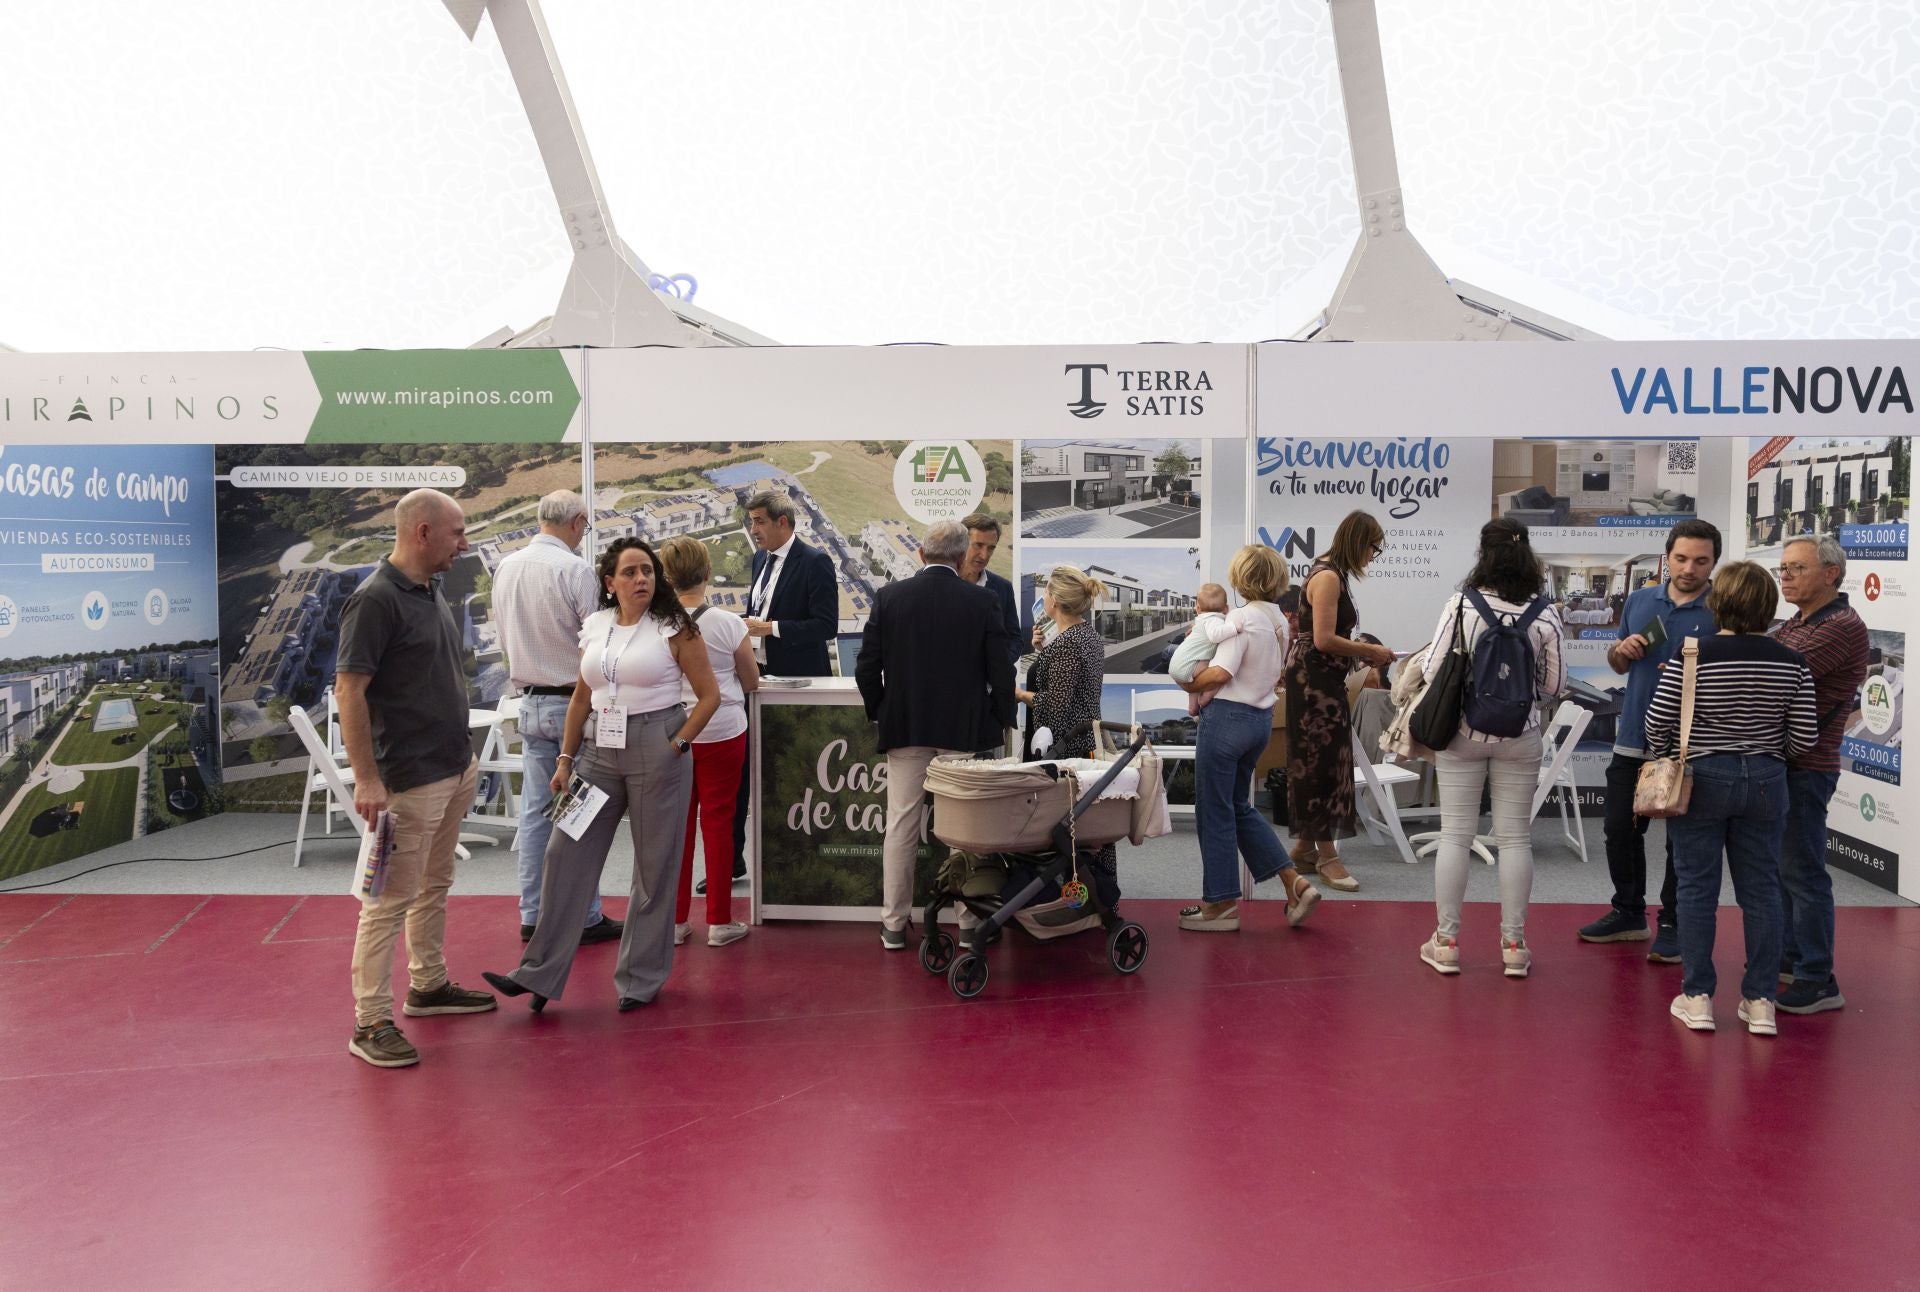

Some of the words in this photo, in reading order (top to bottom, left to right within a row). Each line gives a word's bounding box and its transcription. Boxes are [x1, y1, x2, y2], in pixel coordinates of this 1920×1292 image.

[57, 374, 177, 385] FINCA
[1117, 370, 1214, 391] TERRA
[1610, 365, 1915, 414] VALLENOVA
[336, 387, 554, 409] www.mirapinos.com
[4, 395, 280, 423] IRAPINOS
[1126, 395, 1204, 416] SATIS
[1256, 437, 1451, 477] Bienvenido
[0, 445, 75, 500] asas
[85, 466, 110, 502] de
[116, 472, 189, 518] campo
[239, 471, 300, 483] CAMINO
[306, 471, 349, 483] VIEJO
[355, 471, 374, 483] DE
[380, 471, 458, 483] SIMANCAS
[911, 487, 971, 497] CALIFICACIÓN
[1269, 479, 1286, 496] a
[1283, 470, 1307, 497] tu
[1313, 478, 1366, 496] nuevo
[1370, 468, 1449, 520] hogar
[914, 498, 968, 508] ENERGÉTICA
[927, 508, 947, 517] TIPO
[948, 508, 956, 517] A
[1599, 517, 1609, 526] C/
[1613, 517, 1642, 526] Veinte
[1645, 517, 1656, 526] de
[1659, 517, 1681, 526] Febr
[0, 531, 69, 546] VIENDAS
[75, 532, 192, 547] ECO-SOSTENIBLES
[1382, 529, 1445, 538] MOBILIARIA
[1561, 530, 1568, 538] 2
[1570, 529, 1599, 538] Baños
[1607, 530, 1624, 538] 152
[1855, 528, 1896, 544] 350.000
[1899, 529, 1907, 543] €
[1402, 543, 1439, 551] NUEVA
[1848, 548, 1857, 558] de
[1858, 548, 1864, 558] la
[1865, 548, 1905, 558] Encomienda
[50, 557, 149, 570] AUTOCONSUMO
[1372, 556, 1431, 565] NVERSIÓN
[1367, 570, 1440, 579] CONSULTORA
[21, 606, 50, 614] PANELES
[111, 609, 137, 618] NATURAL
[1567, 641, 1594, 651] Baños
[1848, 742, 1889, 765] 255.000
[1892, 753, 1899, 768] €
[816, 738, 888, 794] Cas
[1855, 763, 1863, 772] La
[1863, 764, 1898, 783] Cistérniga
[786, 787, 836, 836] de
[1826, 837, 1885, 871] allenova.es
